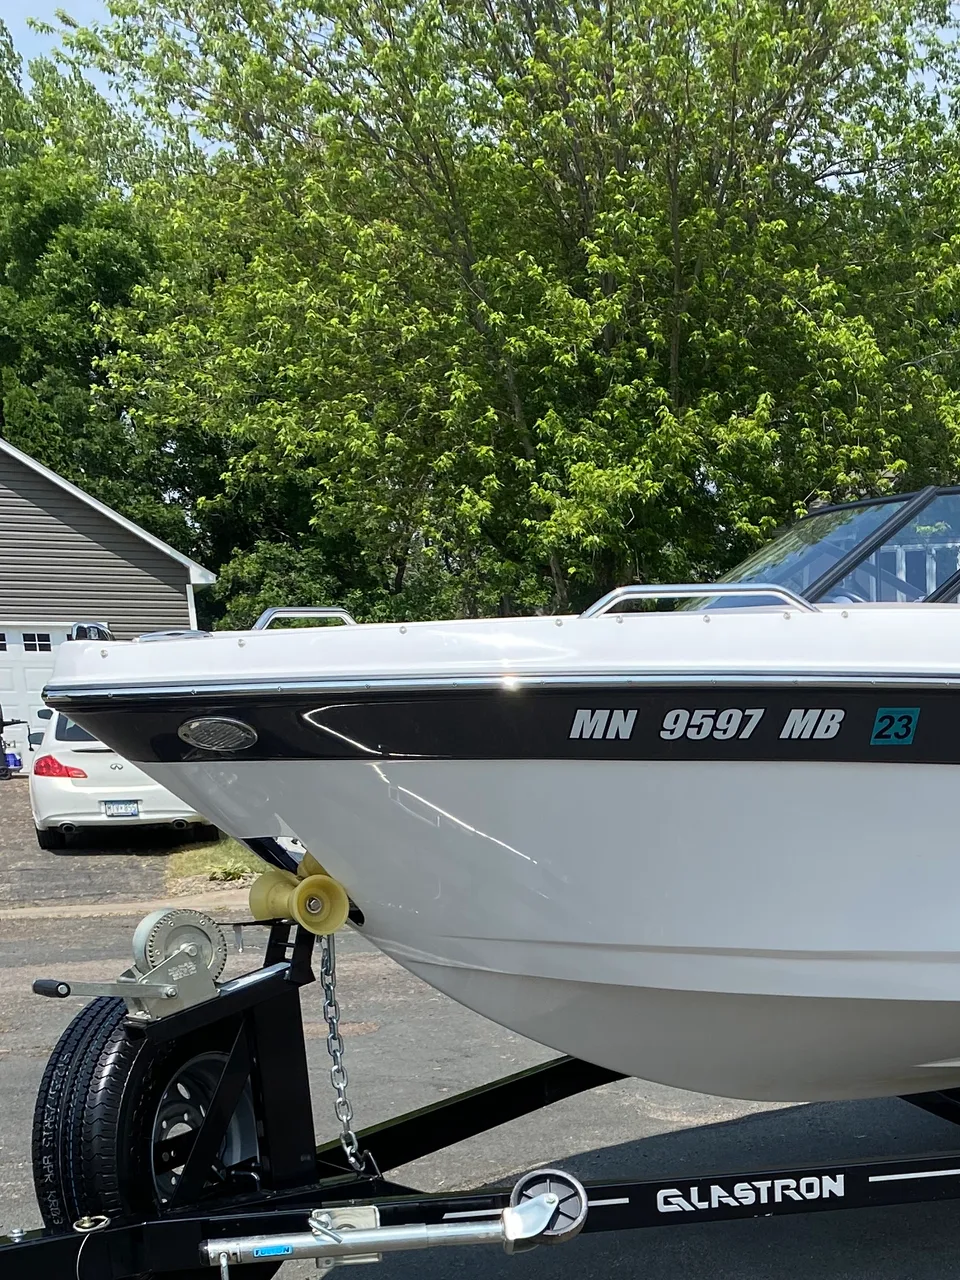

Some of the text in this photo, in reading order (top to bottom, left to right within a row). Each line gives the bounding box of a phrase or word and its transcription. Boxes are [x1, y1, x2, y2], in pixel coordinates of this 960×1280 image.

[569, 708, 845, 740] MN 9597 MB
[873, 714, 913, 740] 23
[656, 1174, 845, 1213] GLASTRON
